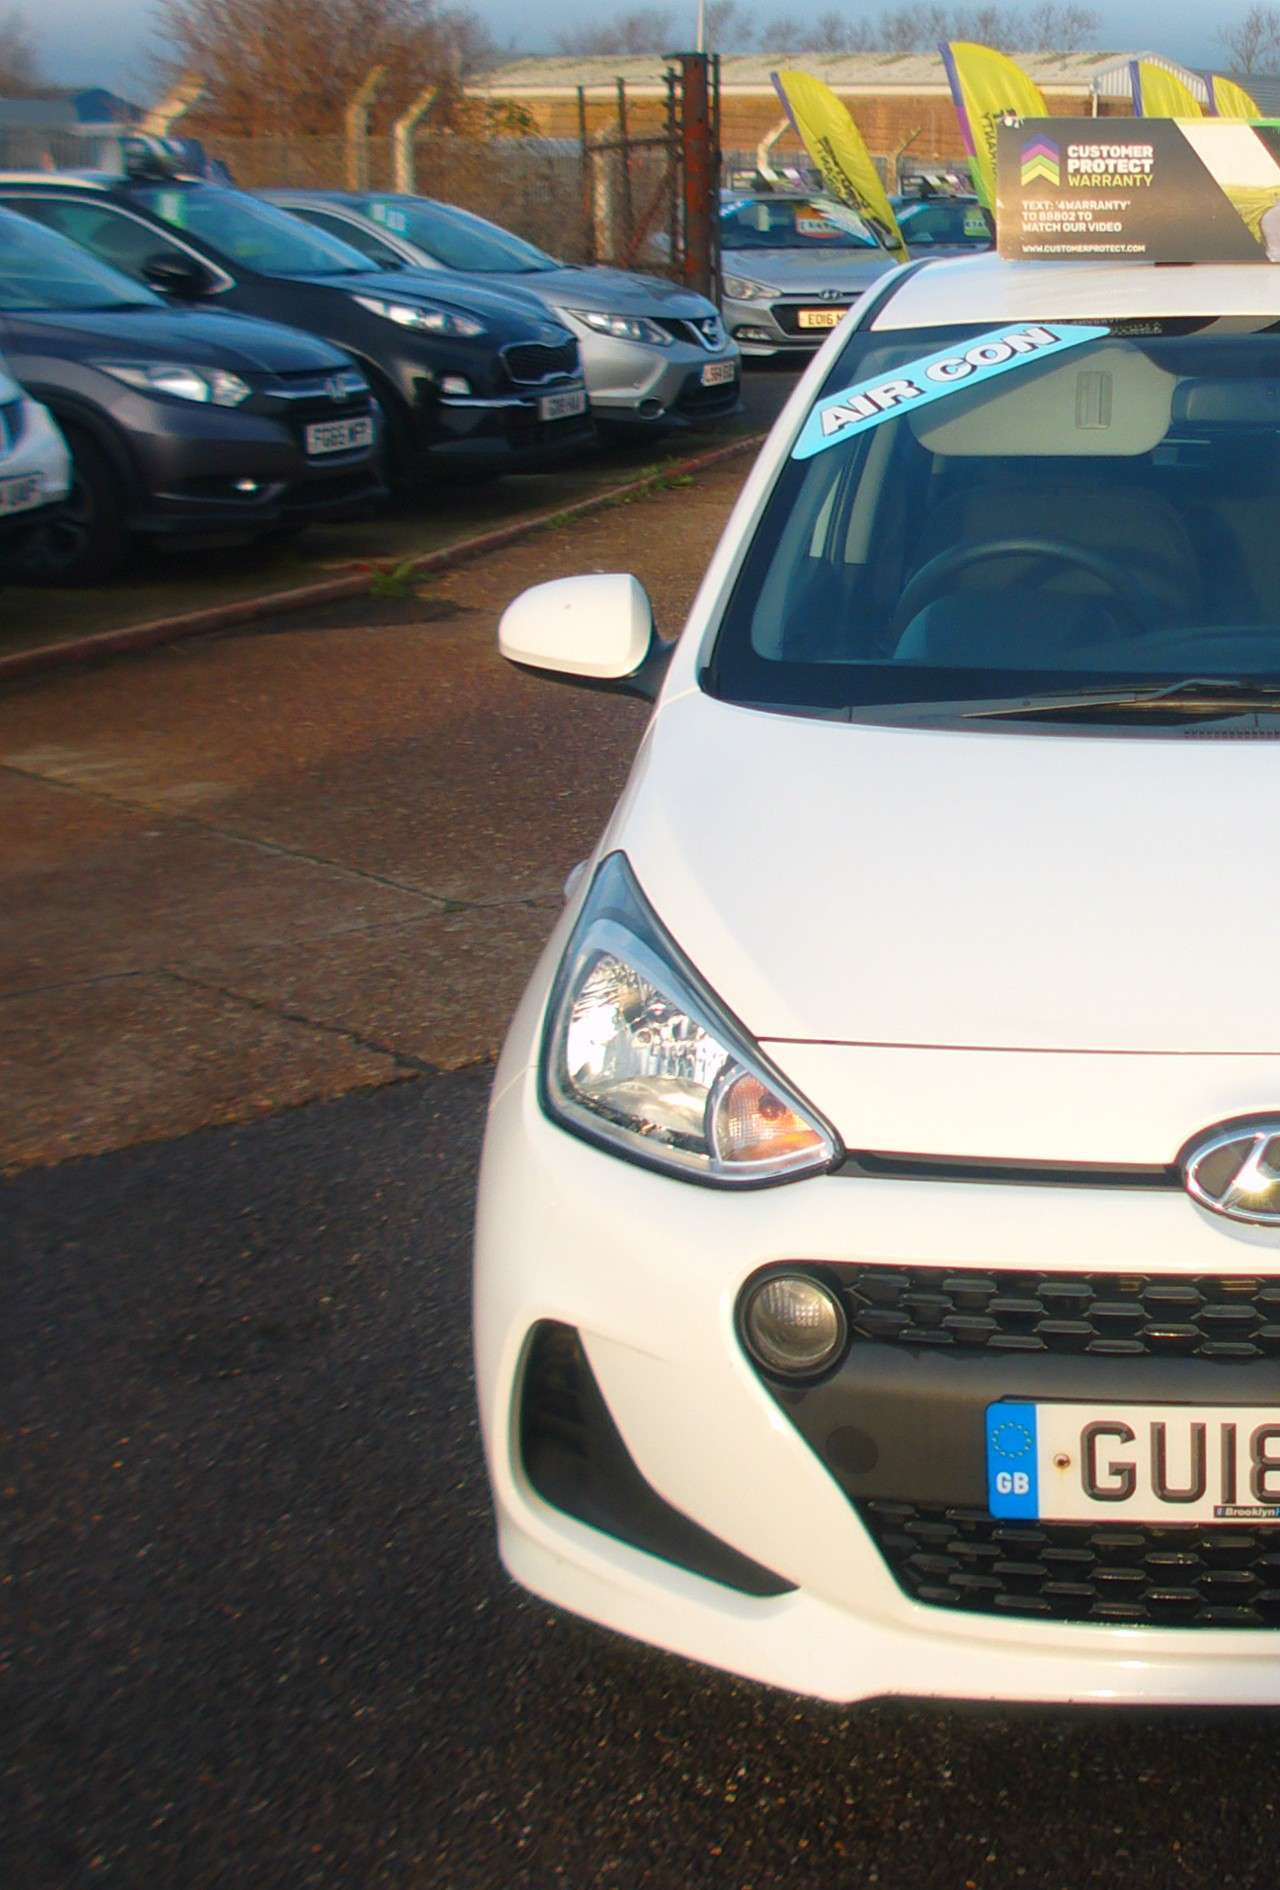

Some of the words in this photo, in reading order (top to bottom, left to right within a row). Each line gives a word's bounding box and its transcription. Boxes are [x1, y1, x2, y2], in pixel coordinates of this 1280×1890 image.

[1067, 145, 1153, 158] CUSTOMER
[1067, 159, 1153, 173] PROTECT
[1067, 174, 1153, 187] WARRANTY
[1022, 201, 1054, 211] TEXT:
[1022, 212, 1037, 221] TO
[1077, 212, 1093, 221] TO
[1022, 223, 1061, 232] WATCH
[1062, 223, 1087, 232] OUR
[1088, 222, 1122, 232] VIDEO
[820, 378, 927, 438] AIR
[925, 327, 1063, 383] CON
[995, 1471, 1029, 1495] GB
